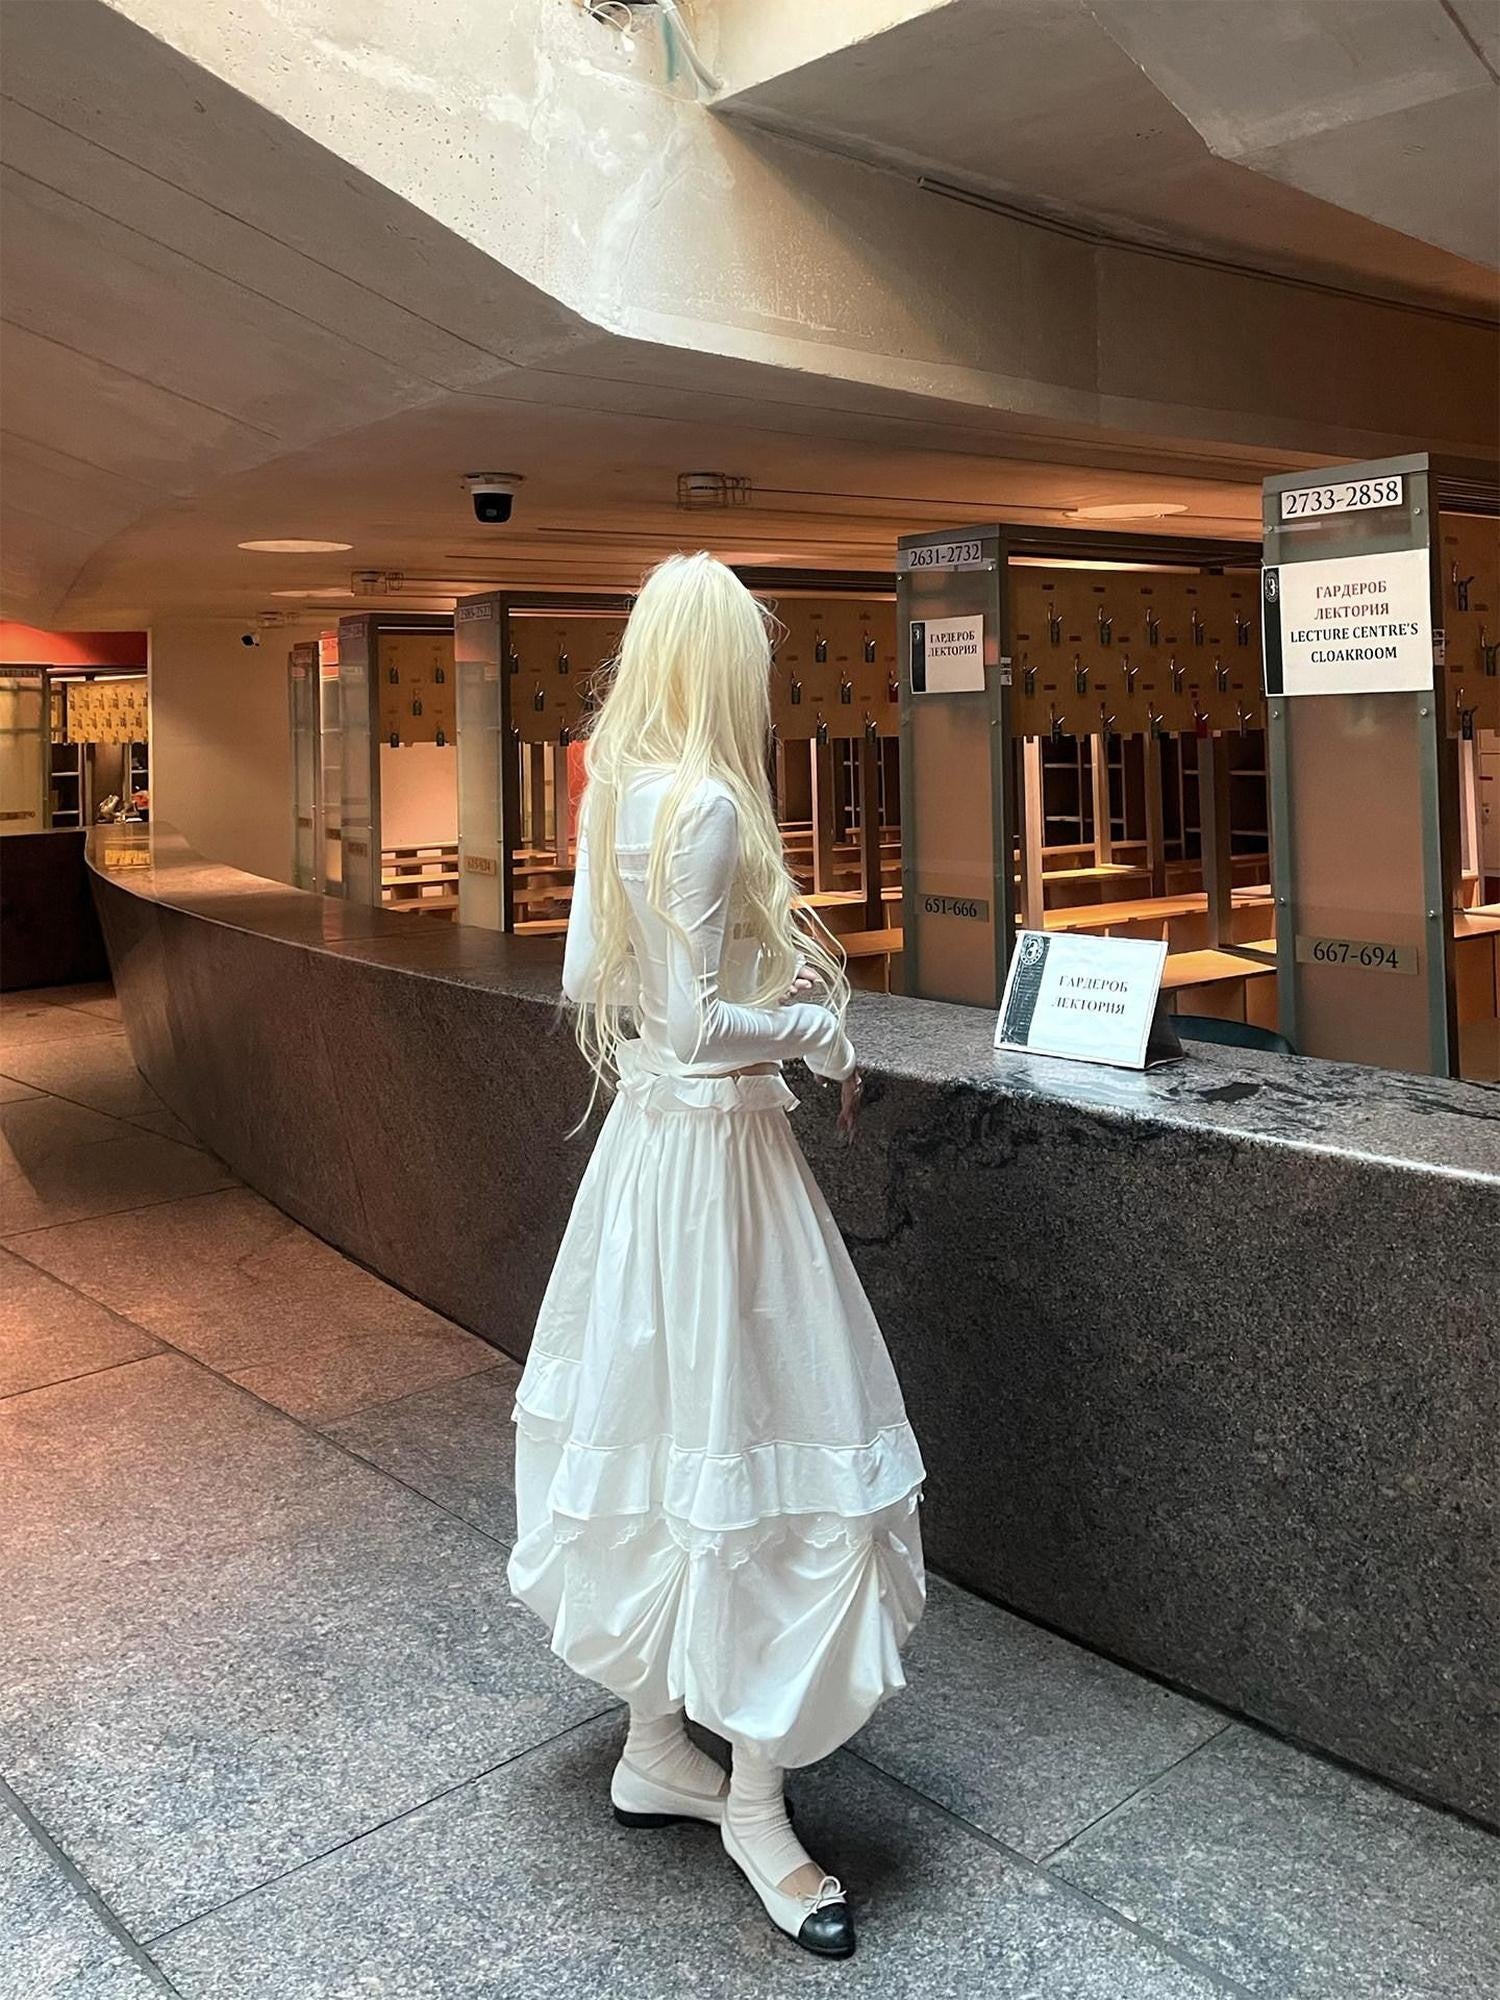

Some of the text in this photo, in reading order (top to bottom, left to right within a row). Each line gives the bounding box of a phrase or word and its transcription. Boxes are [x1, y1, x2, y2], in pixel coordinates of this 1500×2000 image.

[1286, 480, 1399, 515] 2733-2858
[910, 543, 980, 567] 2631-2732
[1316, 580, 1387, 599] ГАРДЕРОБ
[1314, 602, 1389, 620] ЛЕКТОРИЯ
[930, 630, 975, 645] ГАРДЕРОБ
[1290, 622, 1419, 643] LECTURE CENTRE'S
[927, 644, 977, 658] ЛЕКТОРИЯ
[1311, 646, 1397, 663] CLOAKROOM
[925, 897, 977, 917] 651-666
[1313, 941, 1399, 968] 667-694
[1059, 975, 1129, 993] ГАРДЕРОБ
[1051, 997, 1126, 1015] ЛЕКТОРИЯ
